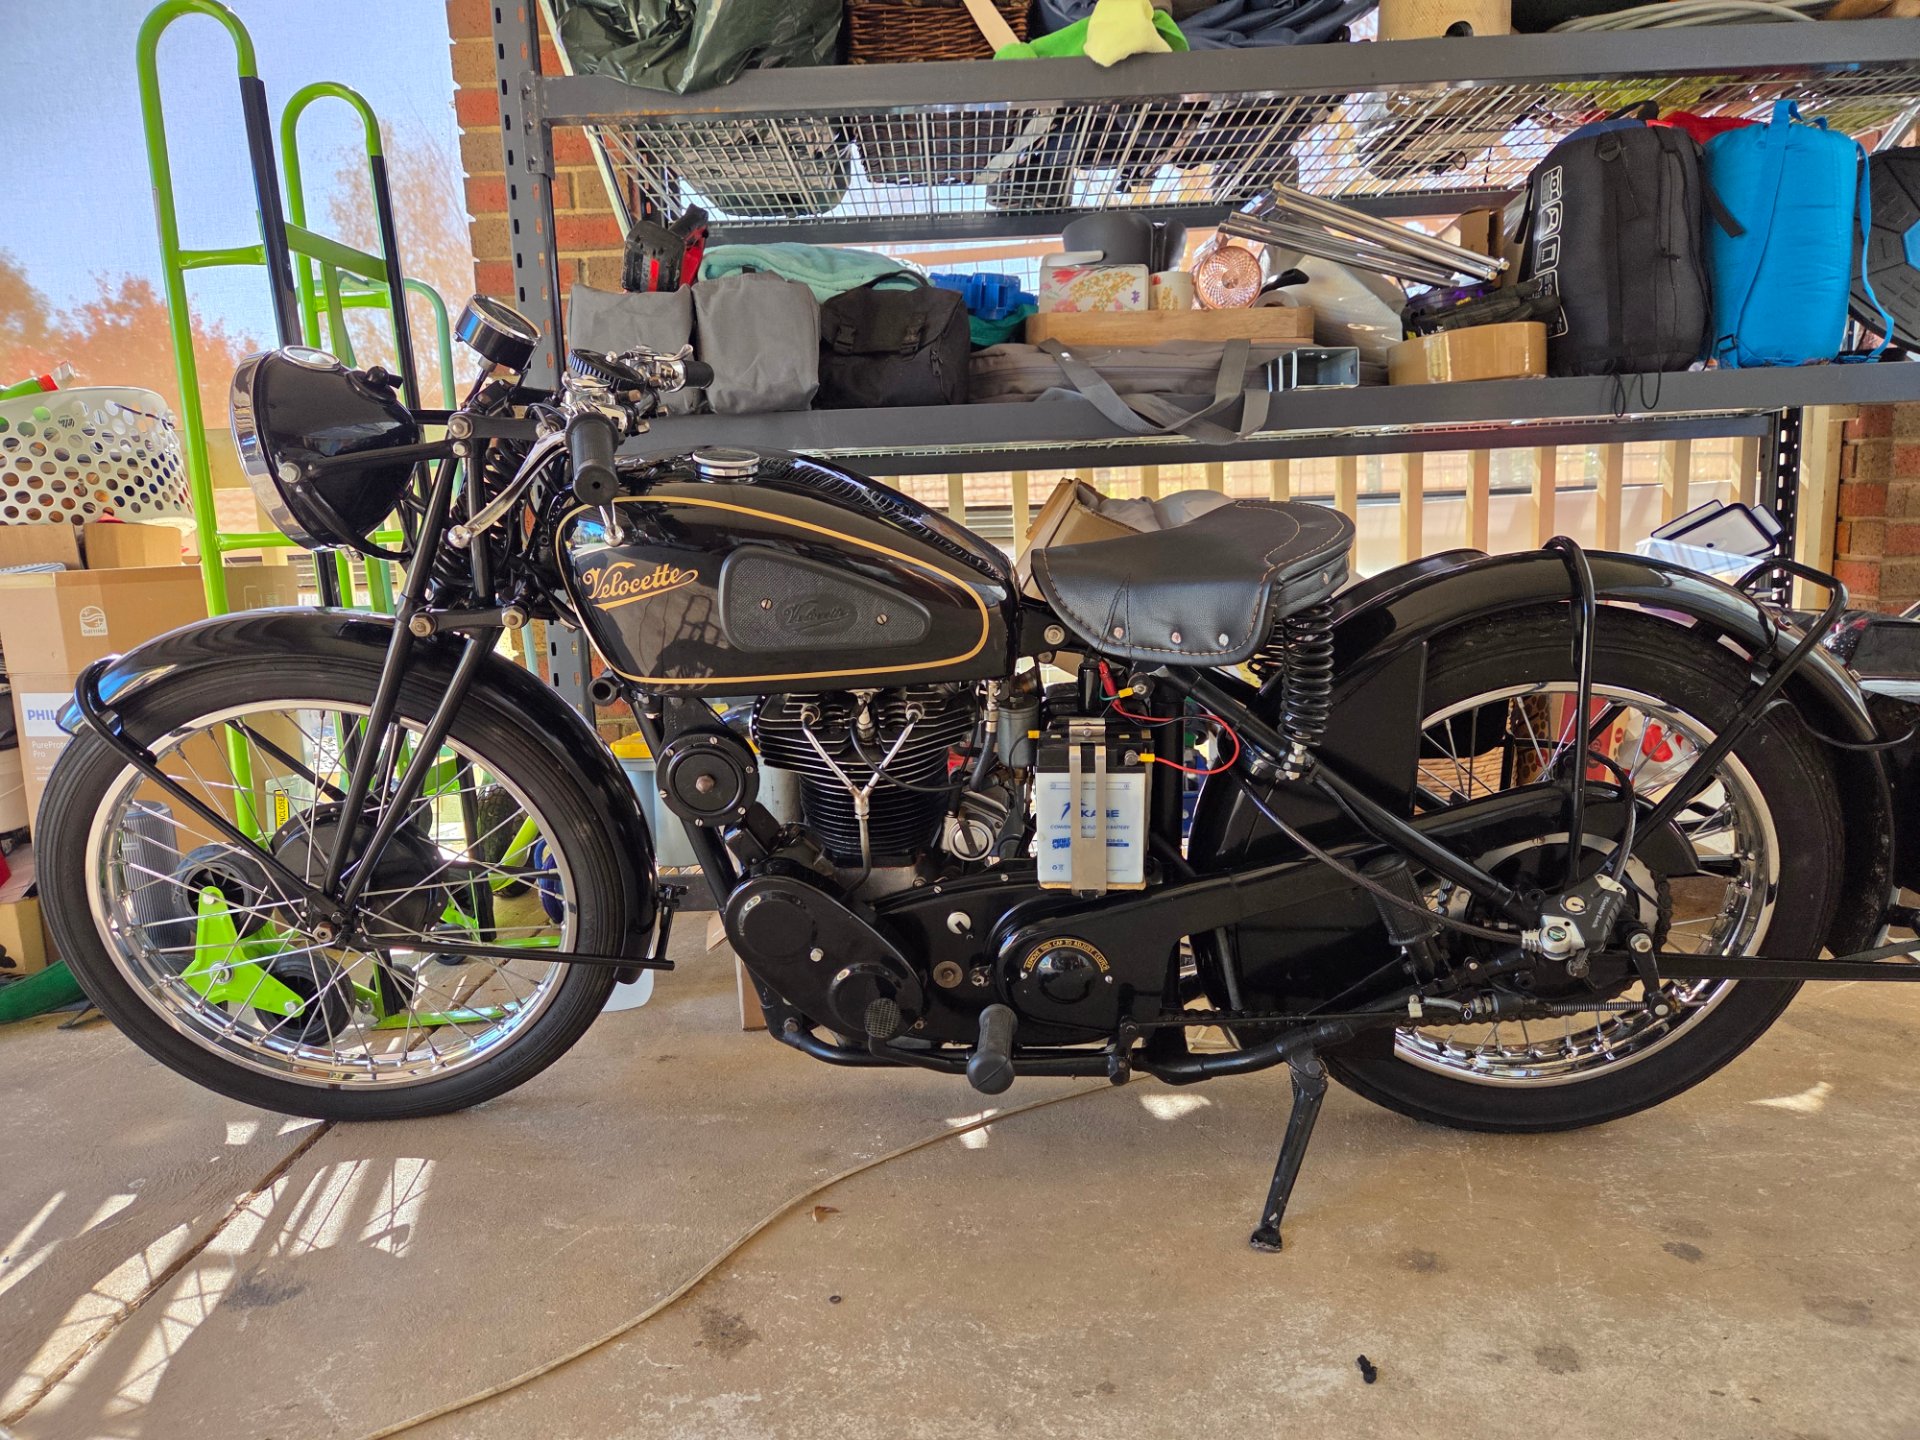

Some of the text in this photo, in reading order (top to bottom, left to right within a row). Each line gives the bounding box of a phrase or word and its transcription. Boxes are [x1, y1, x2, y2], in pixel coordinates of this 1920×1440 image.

[582, 562, 698, 606] Velocette
[27, 709, 56, 721] PHIL
[1026, 950, 1040, 969] REMOVE
[1074, 940, 1093, 953] ADJUST
